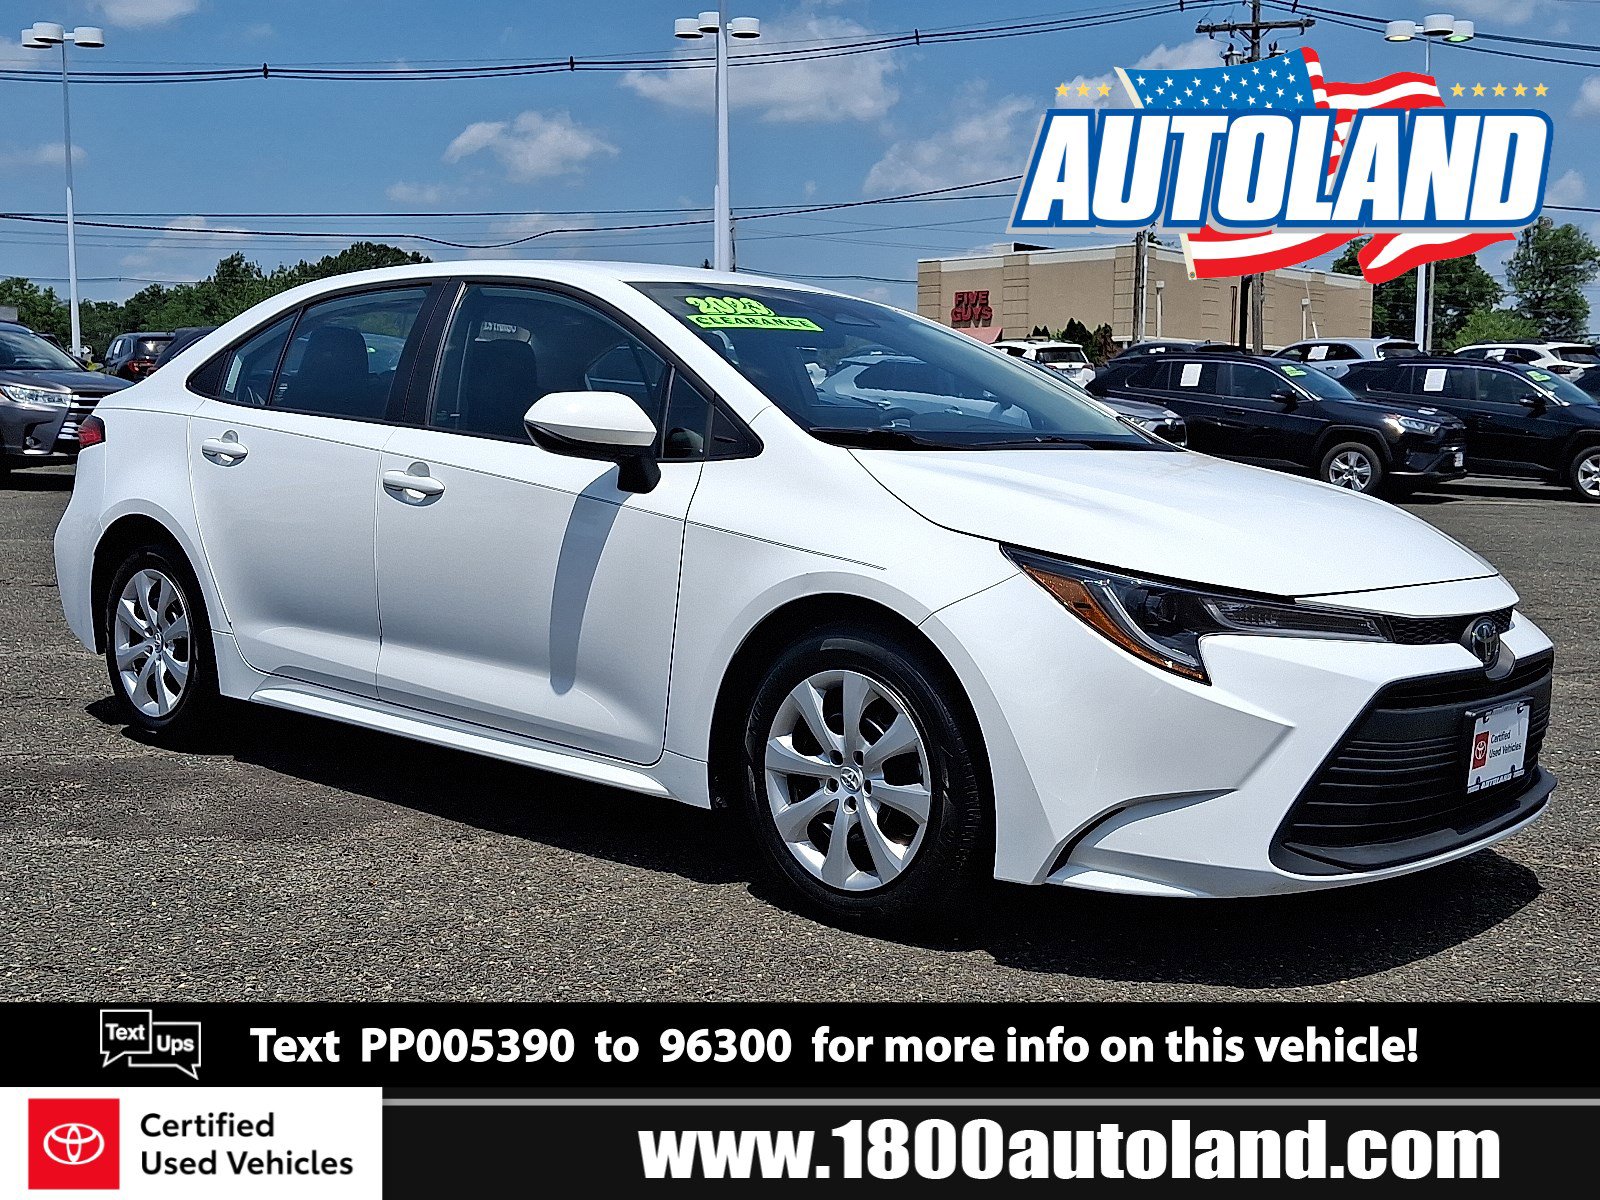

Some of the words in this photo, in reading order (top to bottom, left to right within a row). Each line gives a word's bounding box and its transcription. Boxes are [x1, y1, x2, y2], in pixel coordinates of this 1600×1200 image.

[954, 290, 990, 306] FIVE
[951, 305, 993, 322] GUYS
[695, 316, 814, 330] CLEARANCE
[1490, 730, 1512, 743] Certified
[1489, 747, 1502, 759] Used
[1502, 742, 1522, 754] Vehicles
